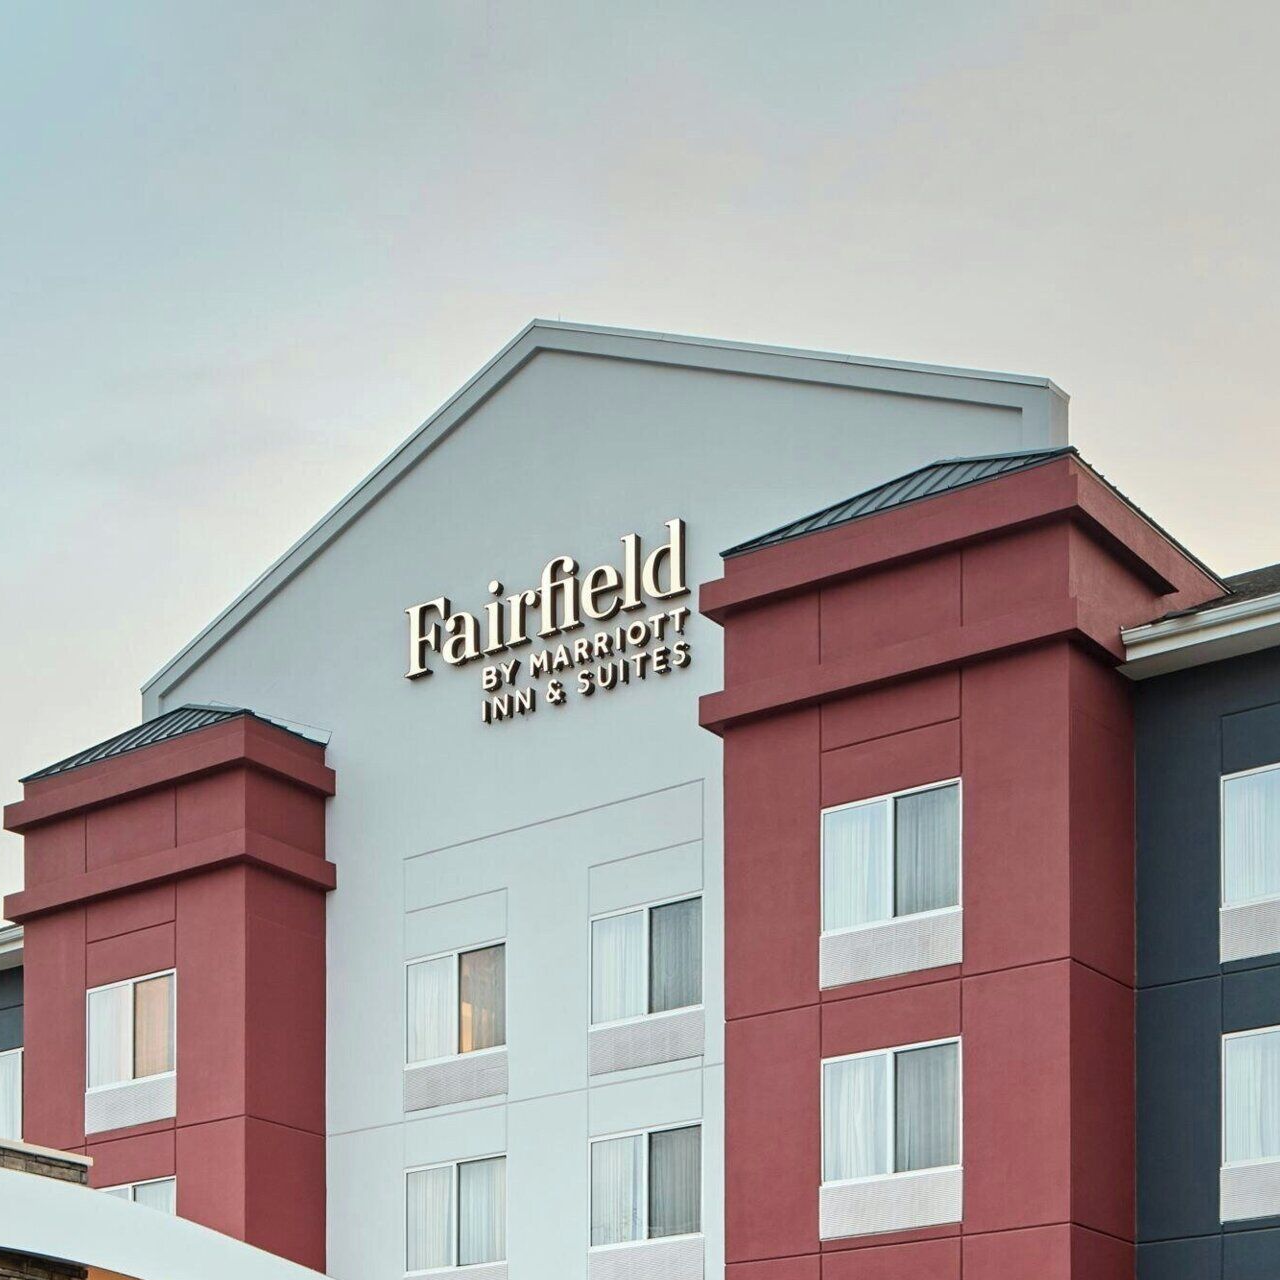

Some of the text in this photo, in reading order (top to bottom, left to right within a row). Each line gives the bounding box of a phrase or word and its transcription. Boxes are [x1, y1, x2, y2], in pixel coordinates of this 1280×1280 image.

[404, 517, 690, 681] Fairfield
[481, 606, 690, 692] BY MARRIOTT
[481, 640, 691, 725] INN & SUITES
